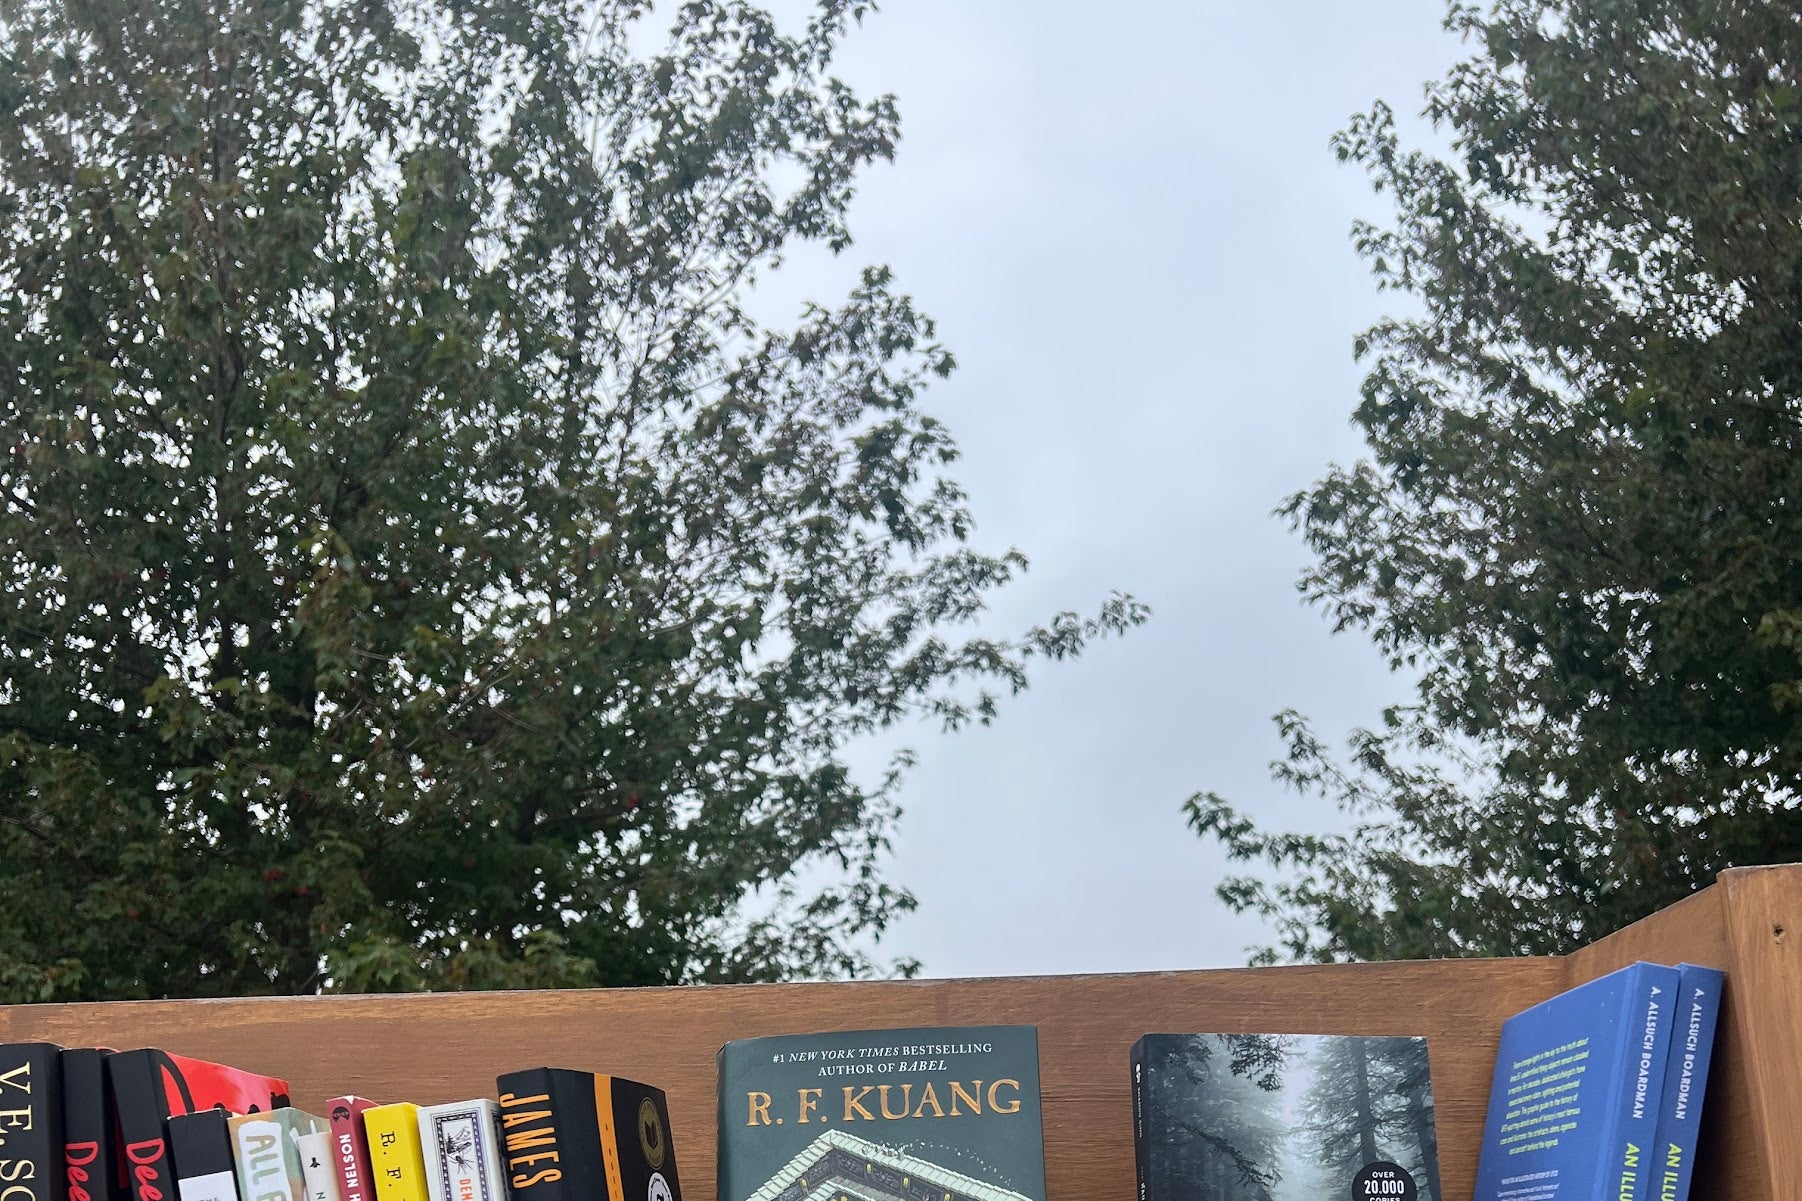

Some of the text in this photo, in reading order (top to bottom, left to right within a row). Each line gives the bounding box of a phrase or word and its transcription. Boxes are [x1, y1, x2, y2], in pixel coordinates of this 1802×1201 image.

[1650, 986, 1662, 998] A.
[1642, 1001, 1659, 1050] ALLSUCH
[773, 1043, 993, 1064] #1 NEW YORK TIMES BESTSELLING
[818, 1060, 948, 1077] AUTHOR OF BABEL
[746, 1078, 1021, 1127] R. F. KUANG
[1632, 1052, 1652, 1119] BOARDMAN
[245, 1135, 276, 1186] ALL
[339, 1133, 359, 1188] NELSON
[500, 1094, 563, 1189] JAMES
[1624, 1142, 1641, 1168] AN
